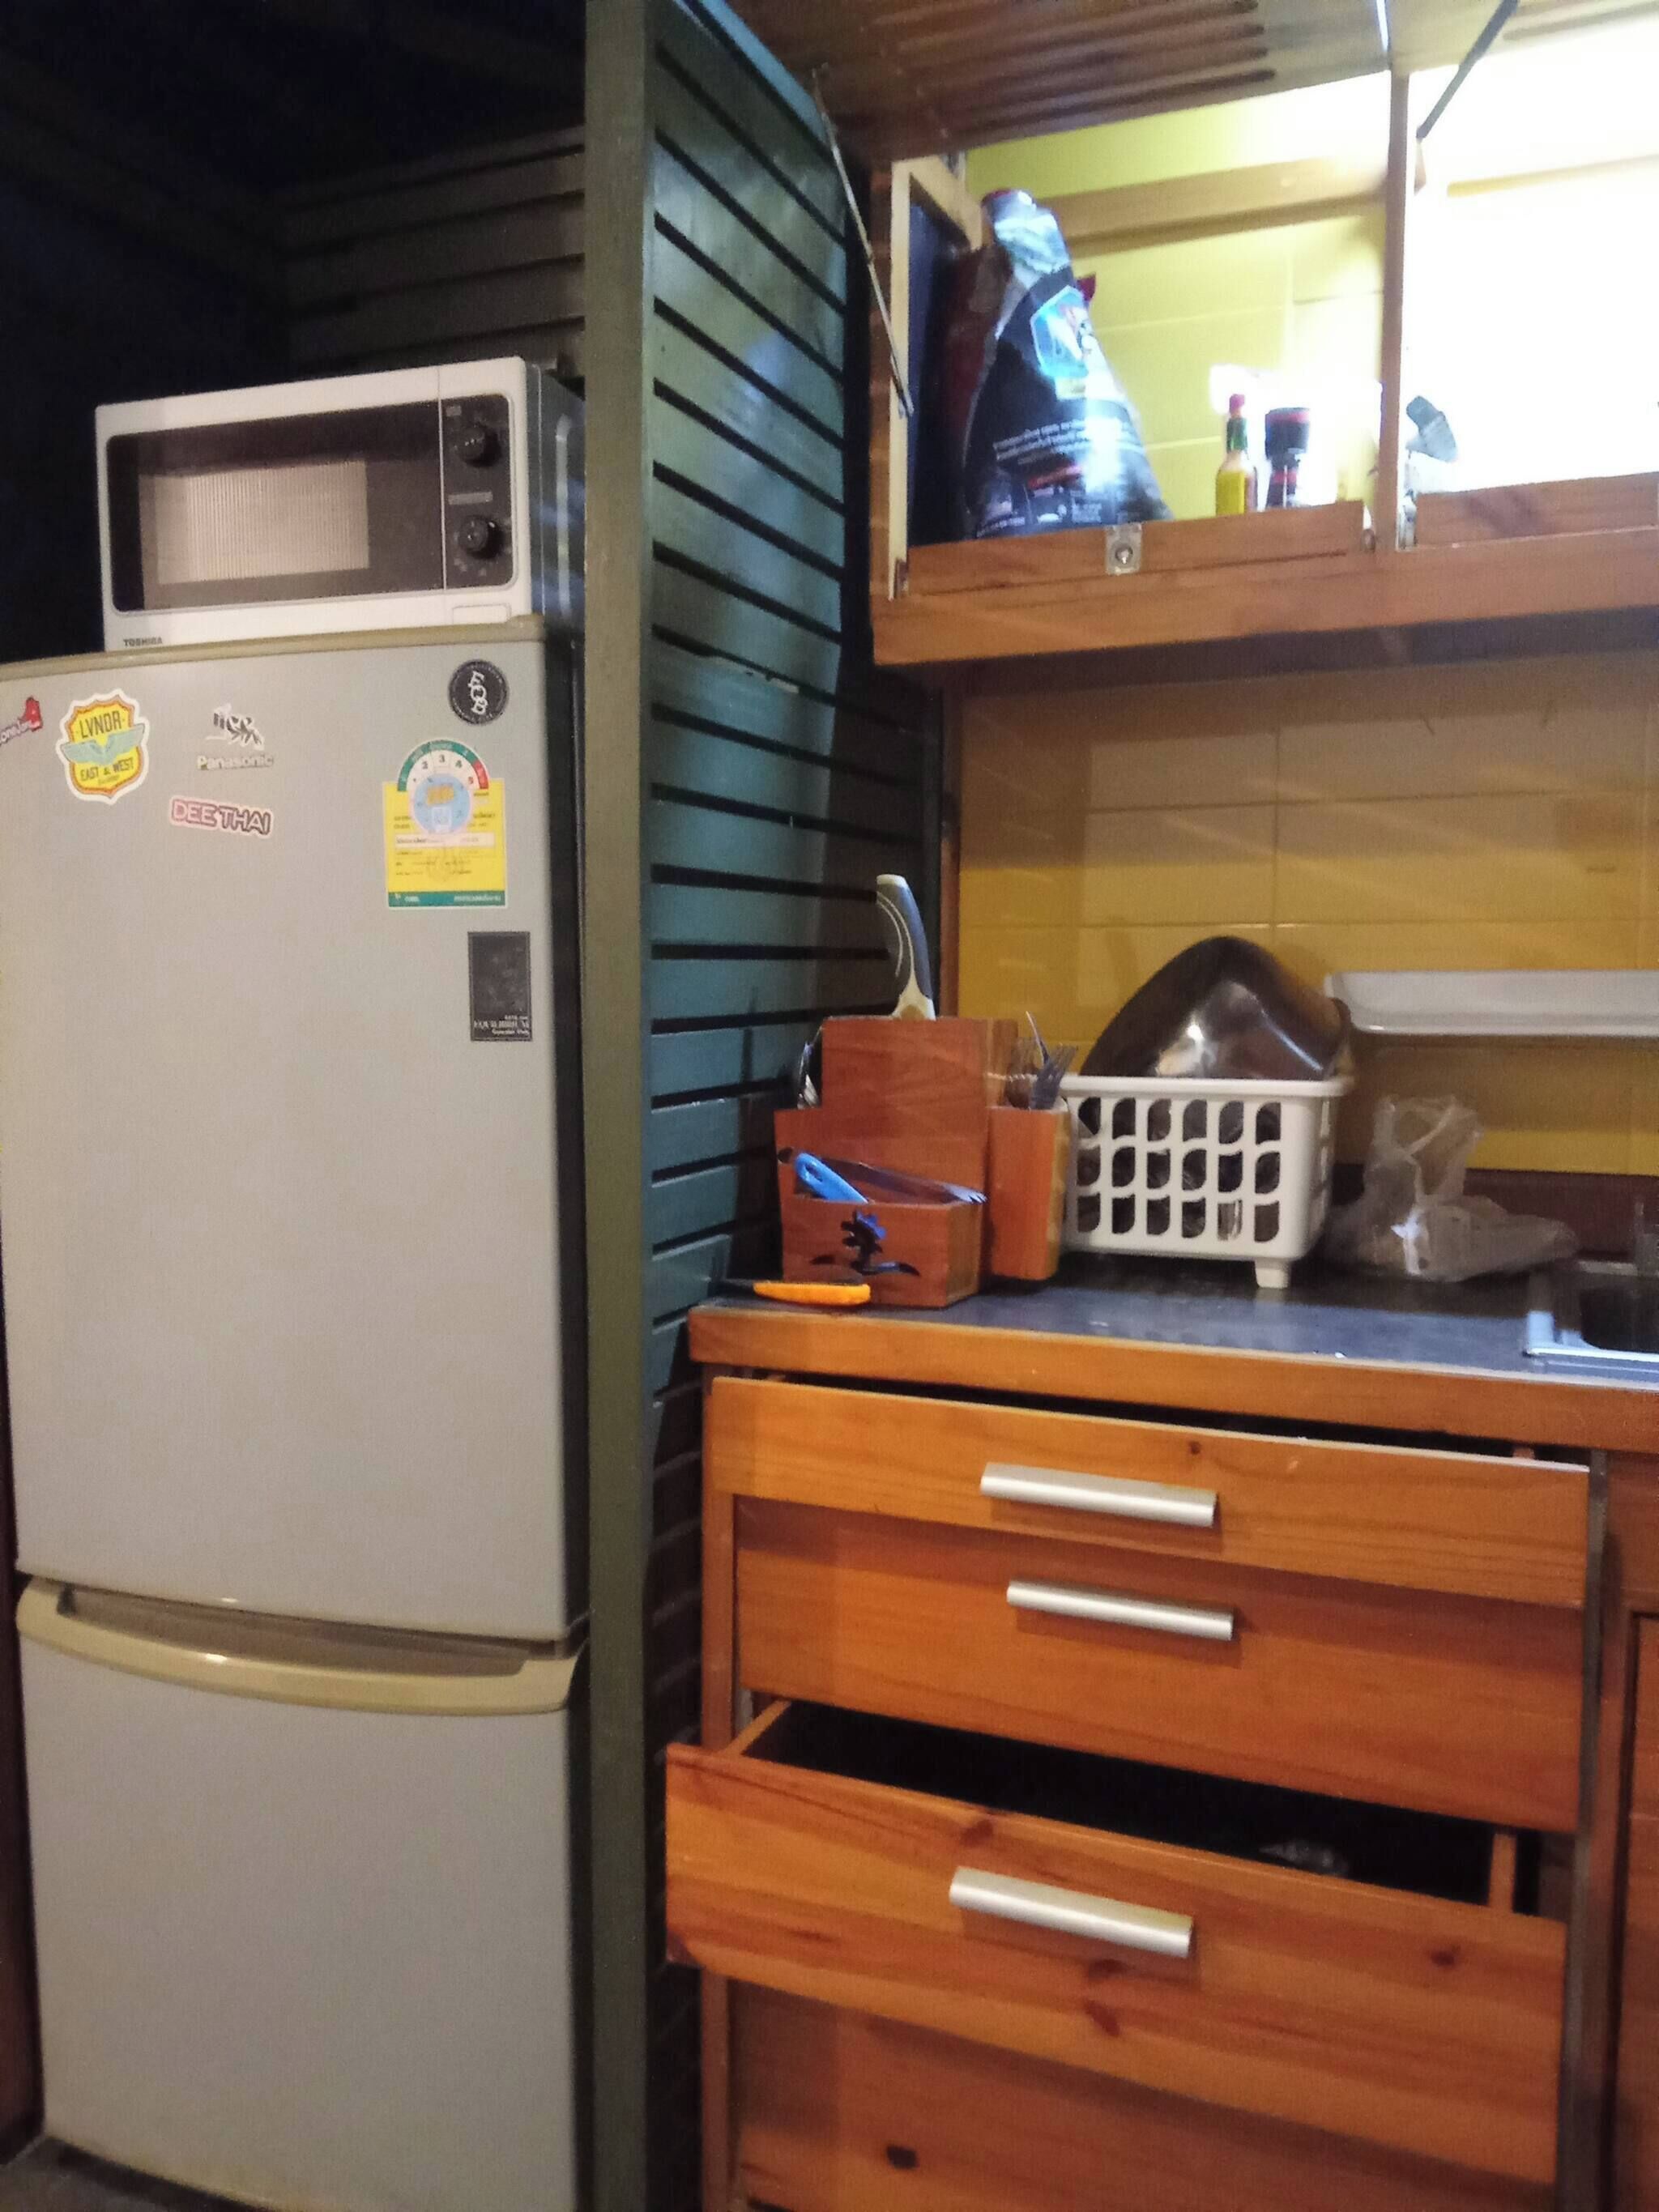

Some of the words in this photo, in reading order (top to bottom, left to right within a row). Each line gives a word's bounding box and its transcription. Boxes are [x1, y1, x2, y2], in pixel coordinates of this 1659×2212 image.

[122, 637, 163, 647] TOSHIBA
[79, 766, 99, 782] EAST
[113, 757, 134, 773] WEST
[197, 753, 274, 770] Panasonic
[171, 798, 218, 828] DEE
[218, 804, 271, 836] THAI
